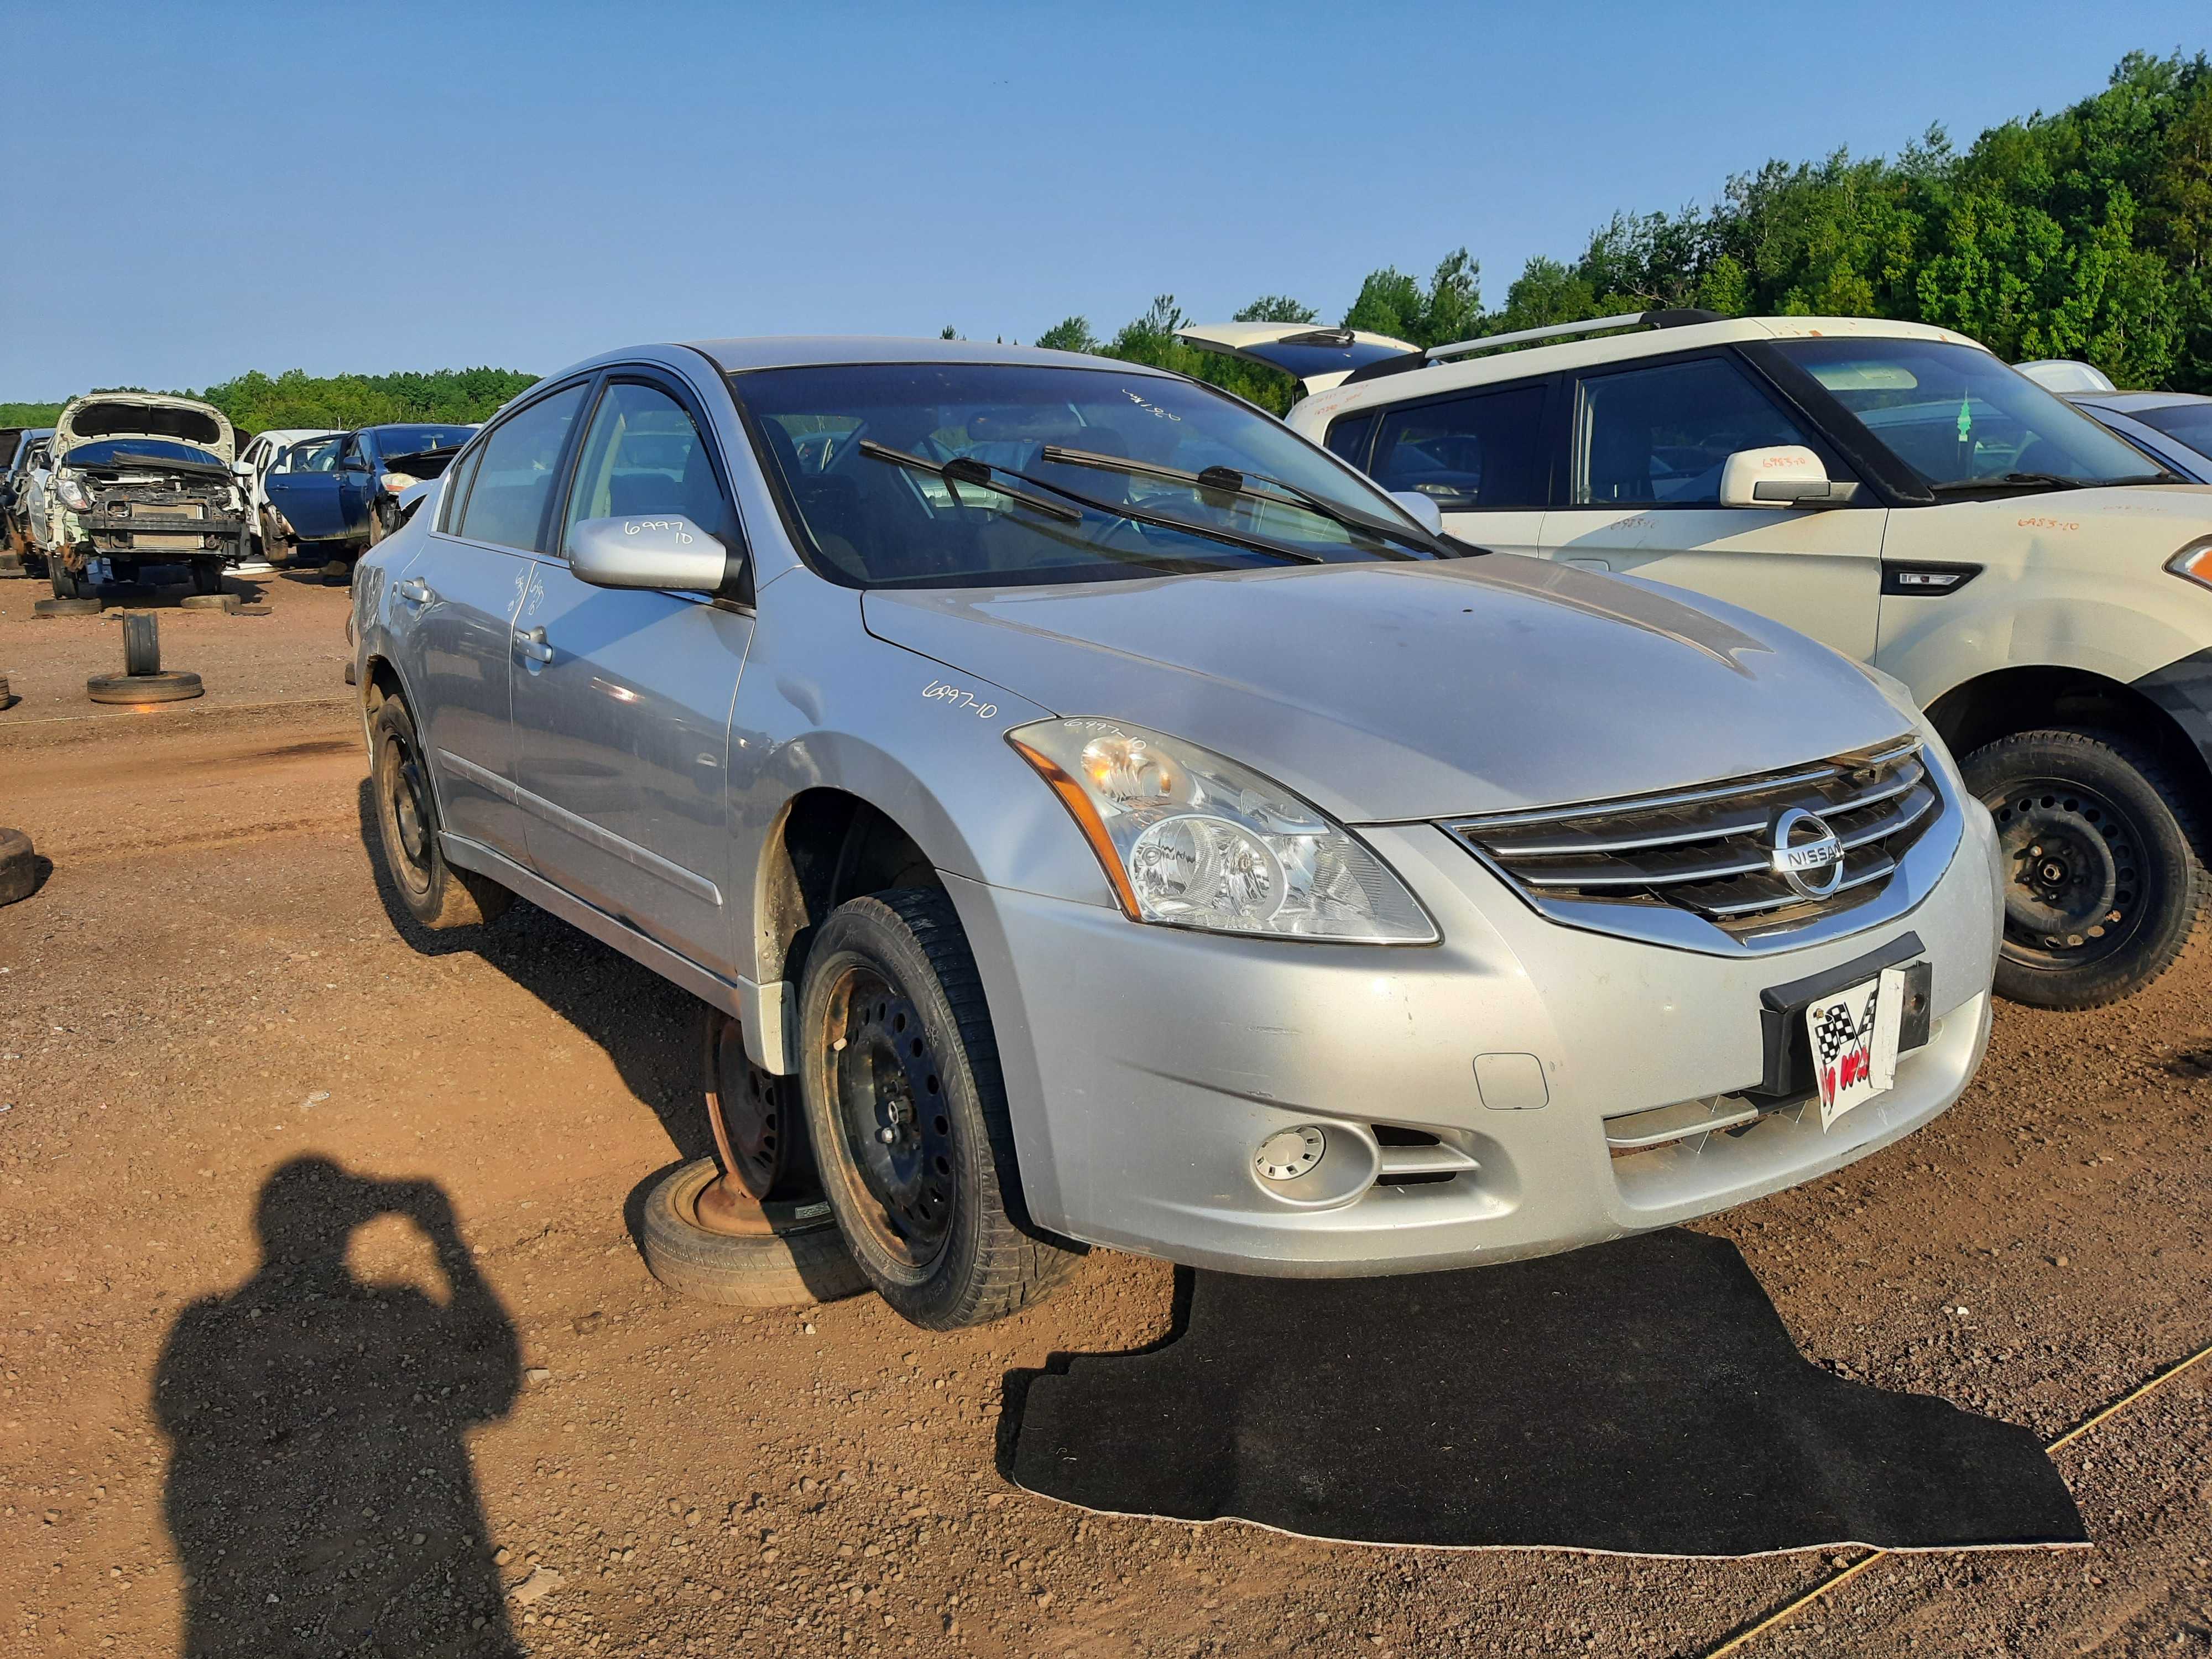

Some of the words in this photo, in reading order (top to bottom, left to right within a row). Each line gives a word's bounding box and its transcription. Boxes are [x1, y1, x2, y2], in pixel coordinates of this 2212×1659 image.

[624, 521, 684, 535] 6997
[675, 531, 693, 544] 10
[922, 680, 998, 719] 6997-10
[1063, 718, 1147, 750] 6997-10
[1787, 839, 1844, 867] NISSAN
